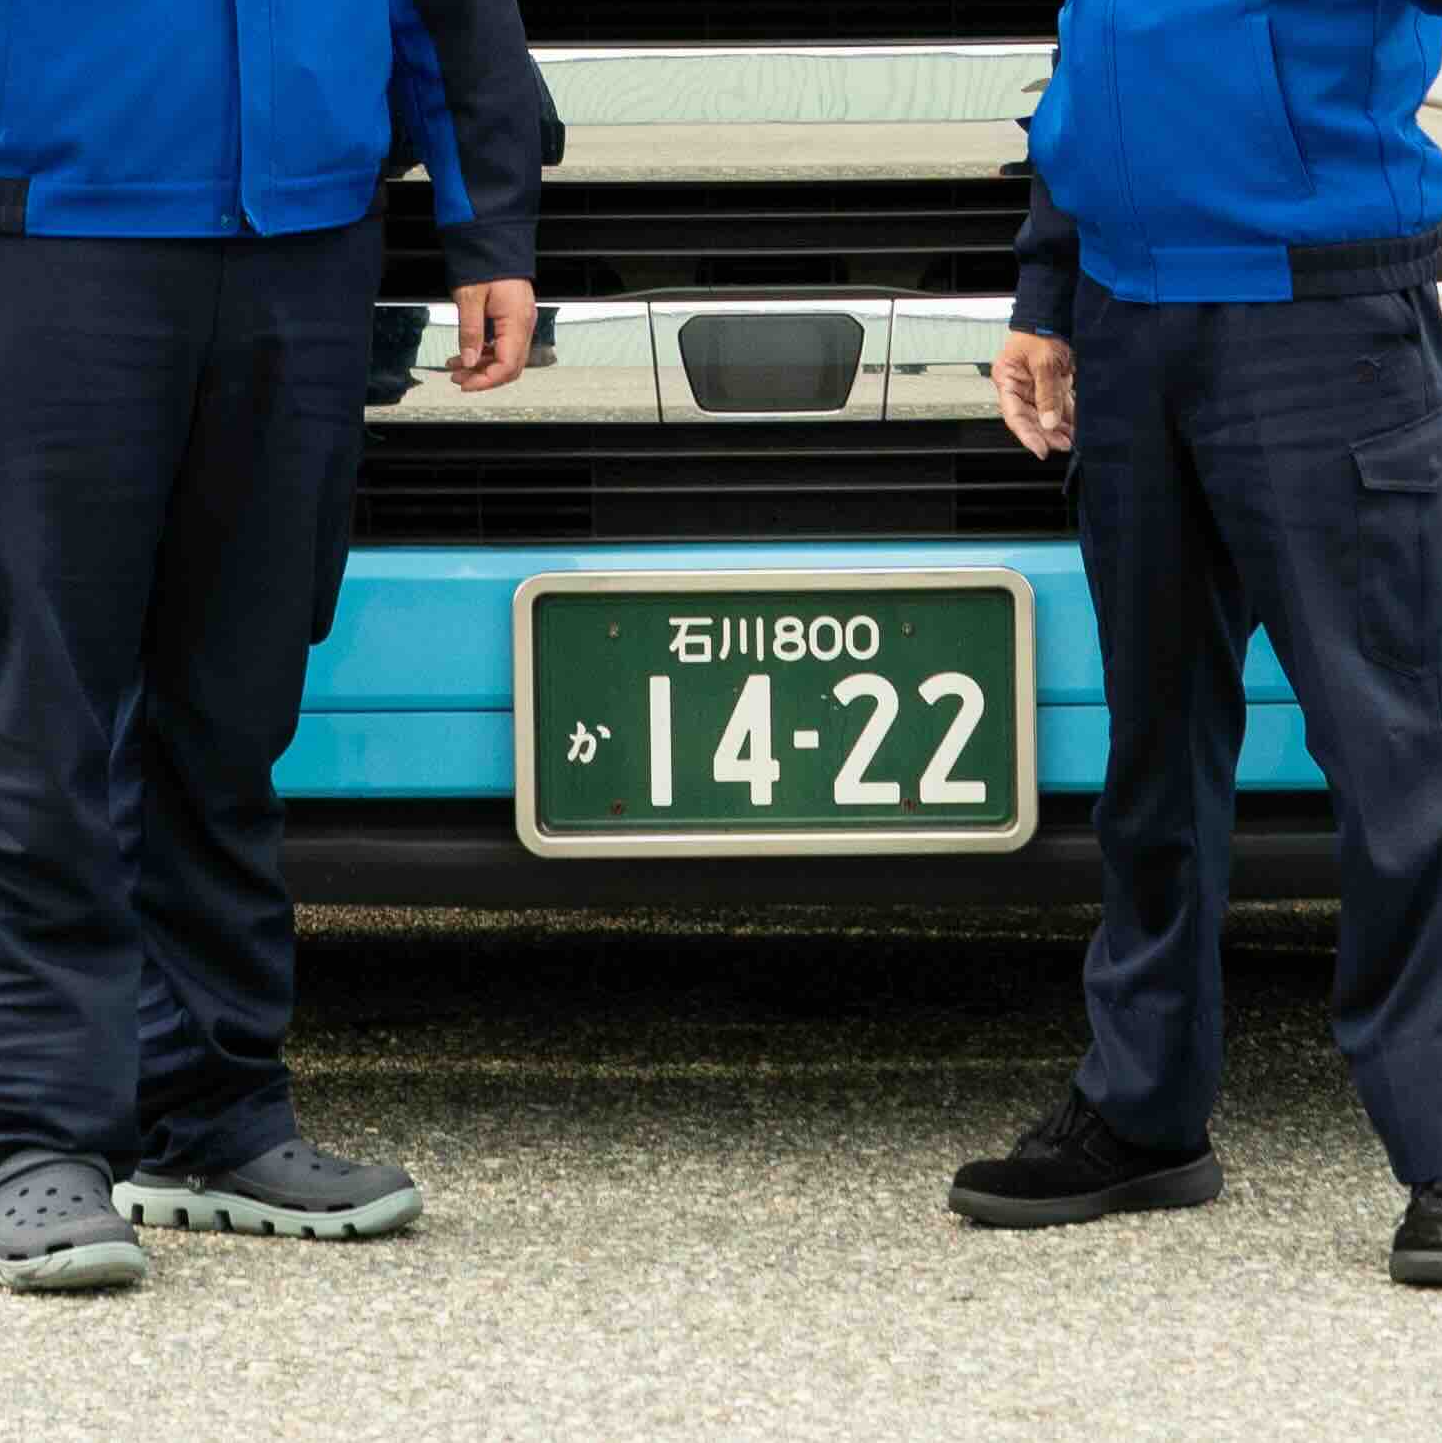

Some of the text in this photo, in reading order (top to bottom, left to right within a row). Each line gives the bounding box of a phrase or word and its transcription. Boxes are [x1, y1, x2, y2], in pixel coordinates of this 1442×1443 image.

[668, 614, 881, 663] 石川800
[567, 672, 987, 807] か 14-22
